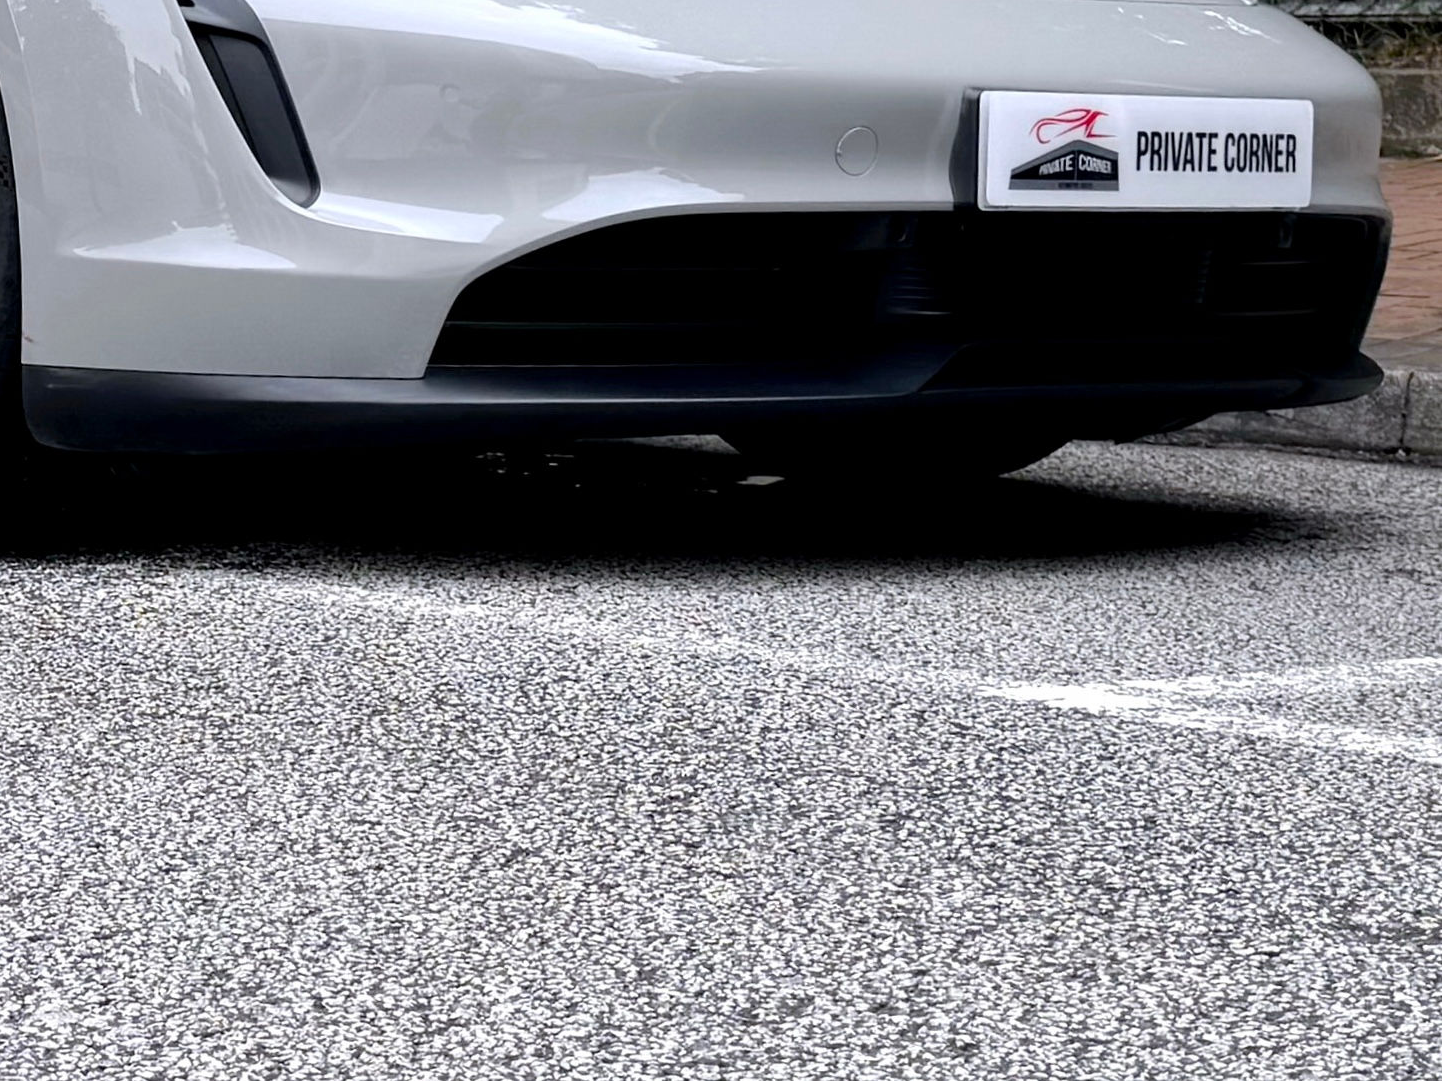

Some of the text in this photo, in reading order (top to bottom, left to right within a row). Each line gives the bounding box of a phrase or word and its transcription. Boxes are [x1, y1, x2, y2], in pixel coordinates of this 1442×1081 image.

[1038, 153, 1112, 176] PRIVATE CORNER
[1135, 131, 1297, 174] PRIVATE CORNER
